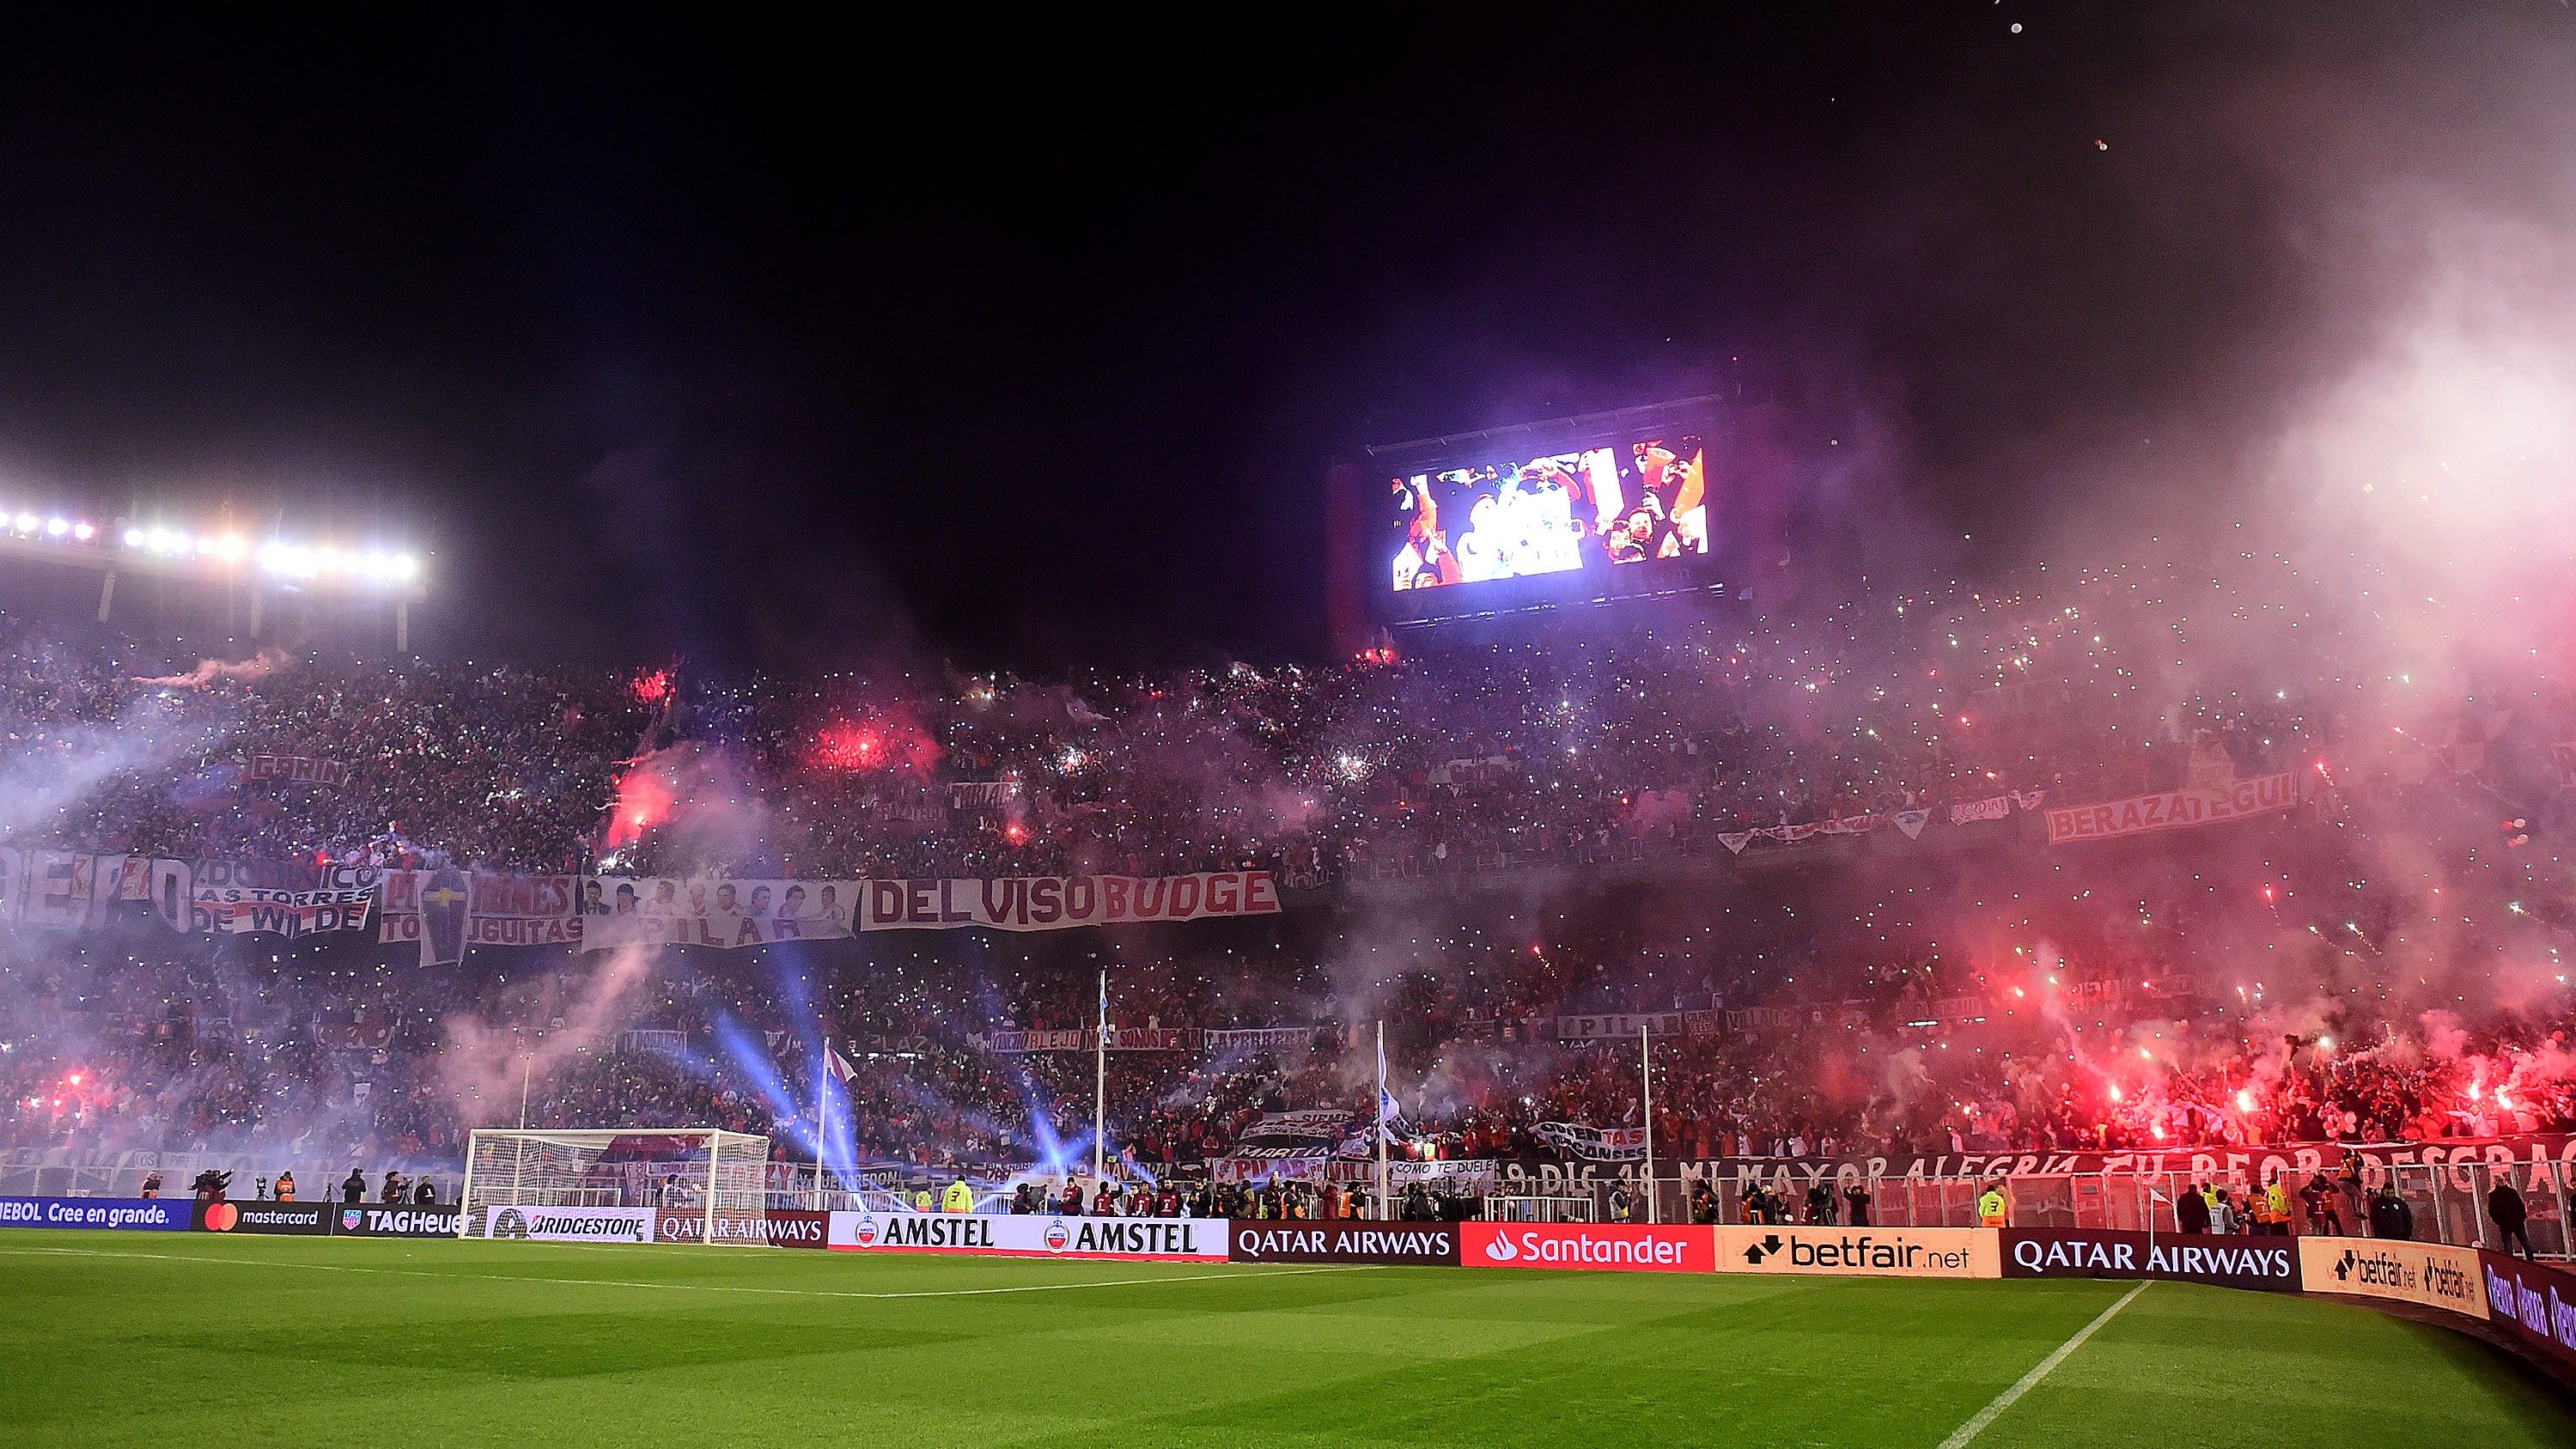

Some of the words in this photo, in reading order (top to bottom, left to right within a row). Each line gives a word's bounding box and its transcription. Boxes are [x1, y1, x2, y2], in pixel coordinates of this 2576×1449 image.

[2053, 776, 2290, 837] BERAZATEGUI
[252, 888, 374, 907] TORRES
[873, 879, 971, 923] DEL
[981, 877, 1097, 925] VISO
[1102, 872, 1276, 918] BUDGE
[250, 903, 364, 938] WILDE
[1396, 1164, 1431, 1175] COMO
[1437, 1163, 1452, 1174] TE
[1457, 1160, 1493, 1174] DUELE
[1736, 1157, 1887, 1196] MAYOR
[1901, 1155, 2080, 1189] ALEGRIA
[47, 1204, 84, 1224] Cree
[87, 1209, 107, 1224] en
[108, 1205, 169, 1228] grande.
[241, 1210, 319, 1227] mastercard
[529, 1215, 645, 1236] BRIDGESTONE
[662, 1216, 730, 1241] QATAR
[734, 1218, 823, 1242] AIRWAYS
[884, 1219, 995, 1248] AMSTEL
[1075, 1222, 1198, 1253] AMSTEL
[1239, 1230, 1326, 1257] QATAR
[1336, 1231, 1450, 1257] AIRWAYS
[1522, 1231, 1688, 1264] Santander
[1791, 1233, 1970, 1269] betfair.net
[2014, 1240, 2135, 1271] QATAR
[2147, 1245, 2291, 1278] AIRWAYS
